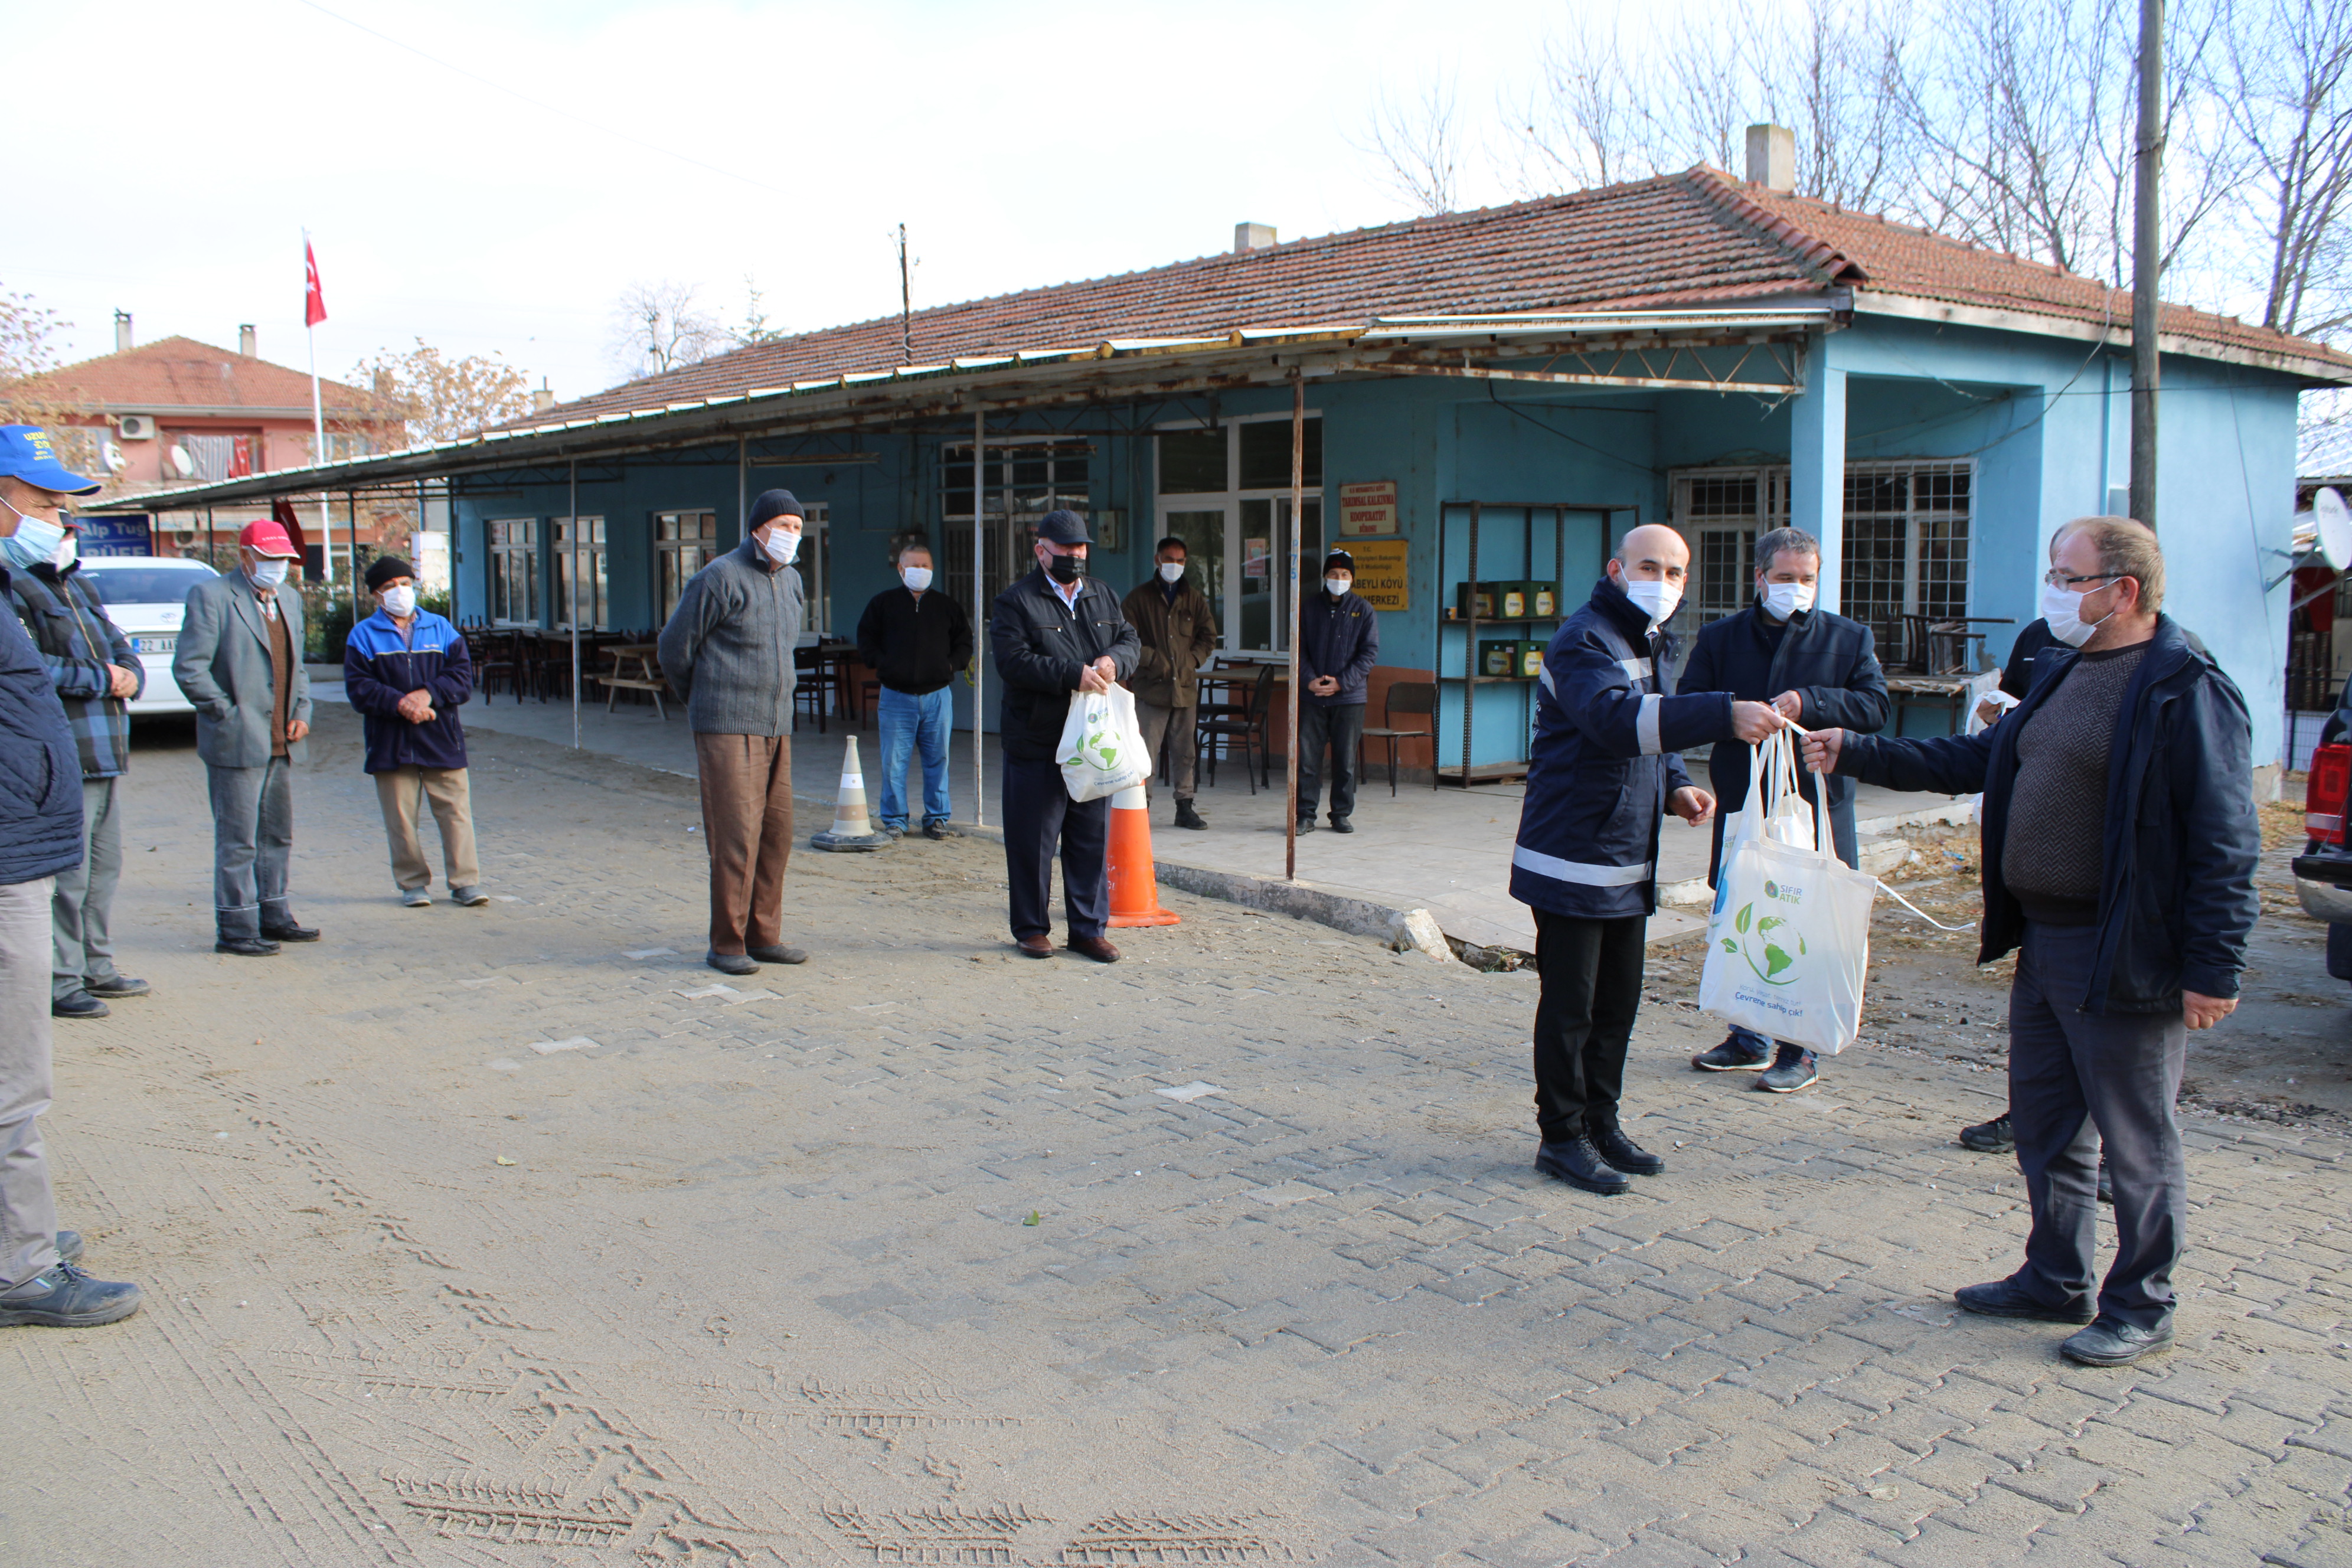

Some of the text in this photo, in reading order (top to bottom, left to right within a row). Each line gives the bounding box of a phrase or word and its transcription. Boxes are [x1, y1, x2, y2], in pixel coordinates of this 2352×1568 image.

[81, 522, 110, 538] Alp
[113, 521, 147, 537] Tuğ
[1351, 576, 1403, 589] ABEYLİ KÖYÜ
[141, 640, 153, 651] 22
[1780, 885, 1802, 896] SIFIR
[1779, 893, 1801, 904] ATIK
[1735, 992, 1765, 1007] Çevrene
[1767, 1002, 1786, 1014] sahip
